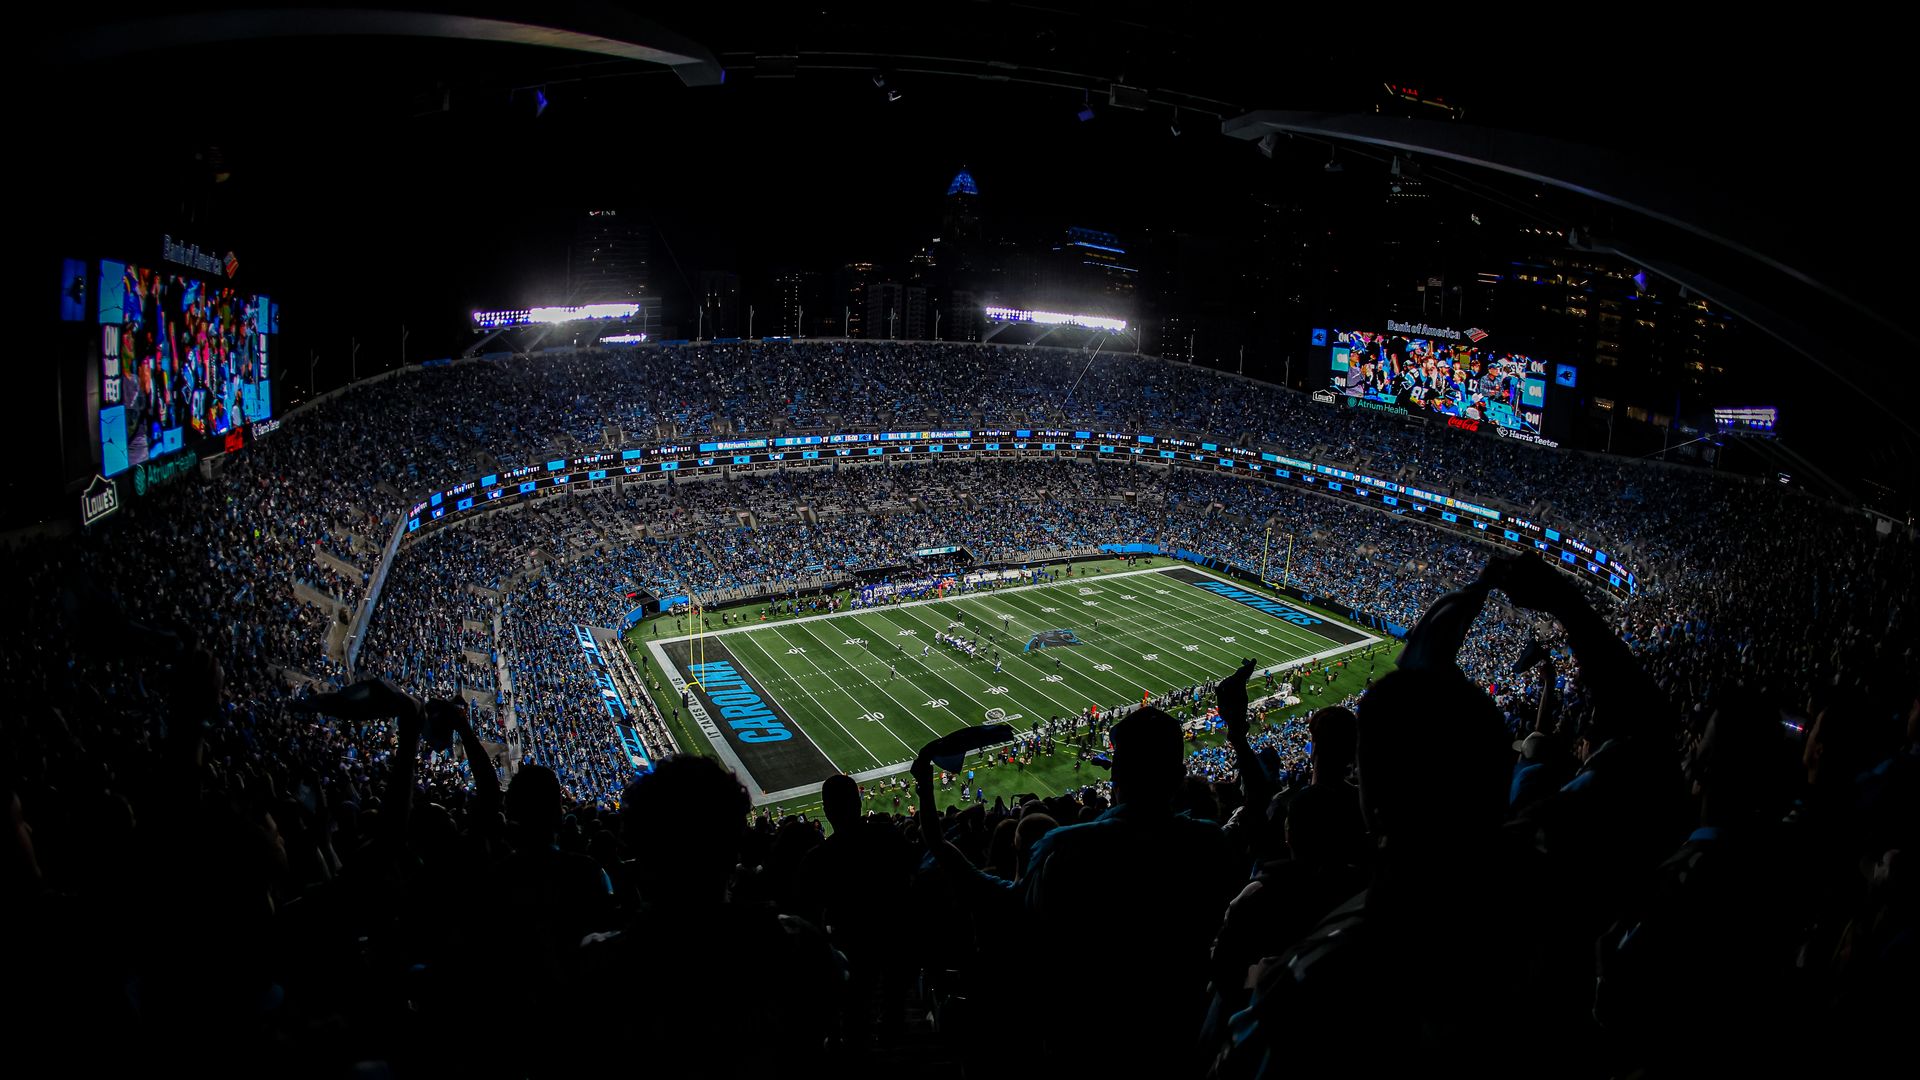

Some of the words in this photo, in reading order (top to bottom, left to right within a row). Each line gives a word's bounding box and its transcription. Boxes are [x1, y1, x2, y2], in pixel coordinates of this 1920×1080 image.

[1387, 320, 1410, 333] Bank
[1411, 322, 1420, 334] of
[1420, 323, 1461, 340] America
[1357, 400, 1383, 411] Atrium
[1384, 404, 1409, 416] Health
[1509, 429, 1533, 442] Harris
[1534, 435, 1559, 448] Teeter
[1193, 581, 1323, 626] PANTHERS
[687, 660, 793, 743] CAROLINA
[927, 698, 949, 708] 20
[863, 711, 885, 722] 10
